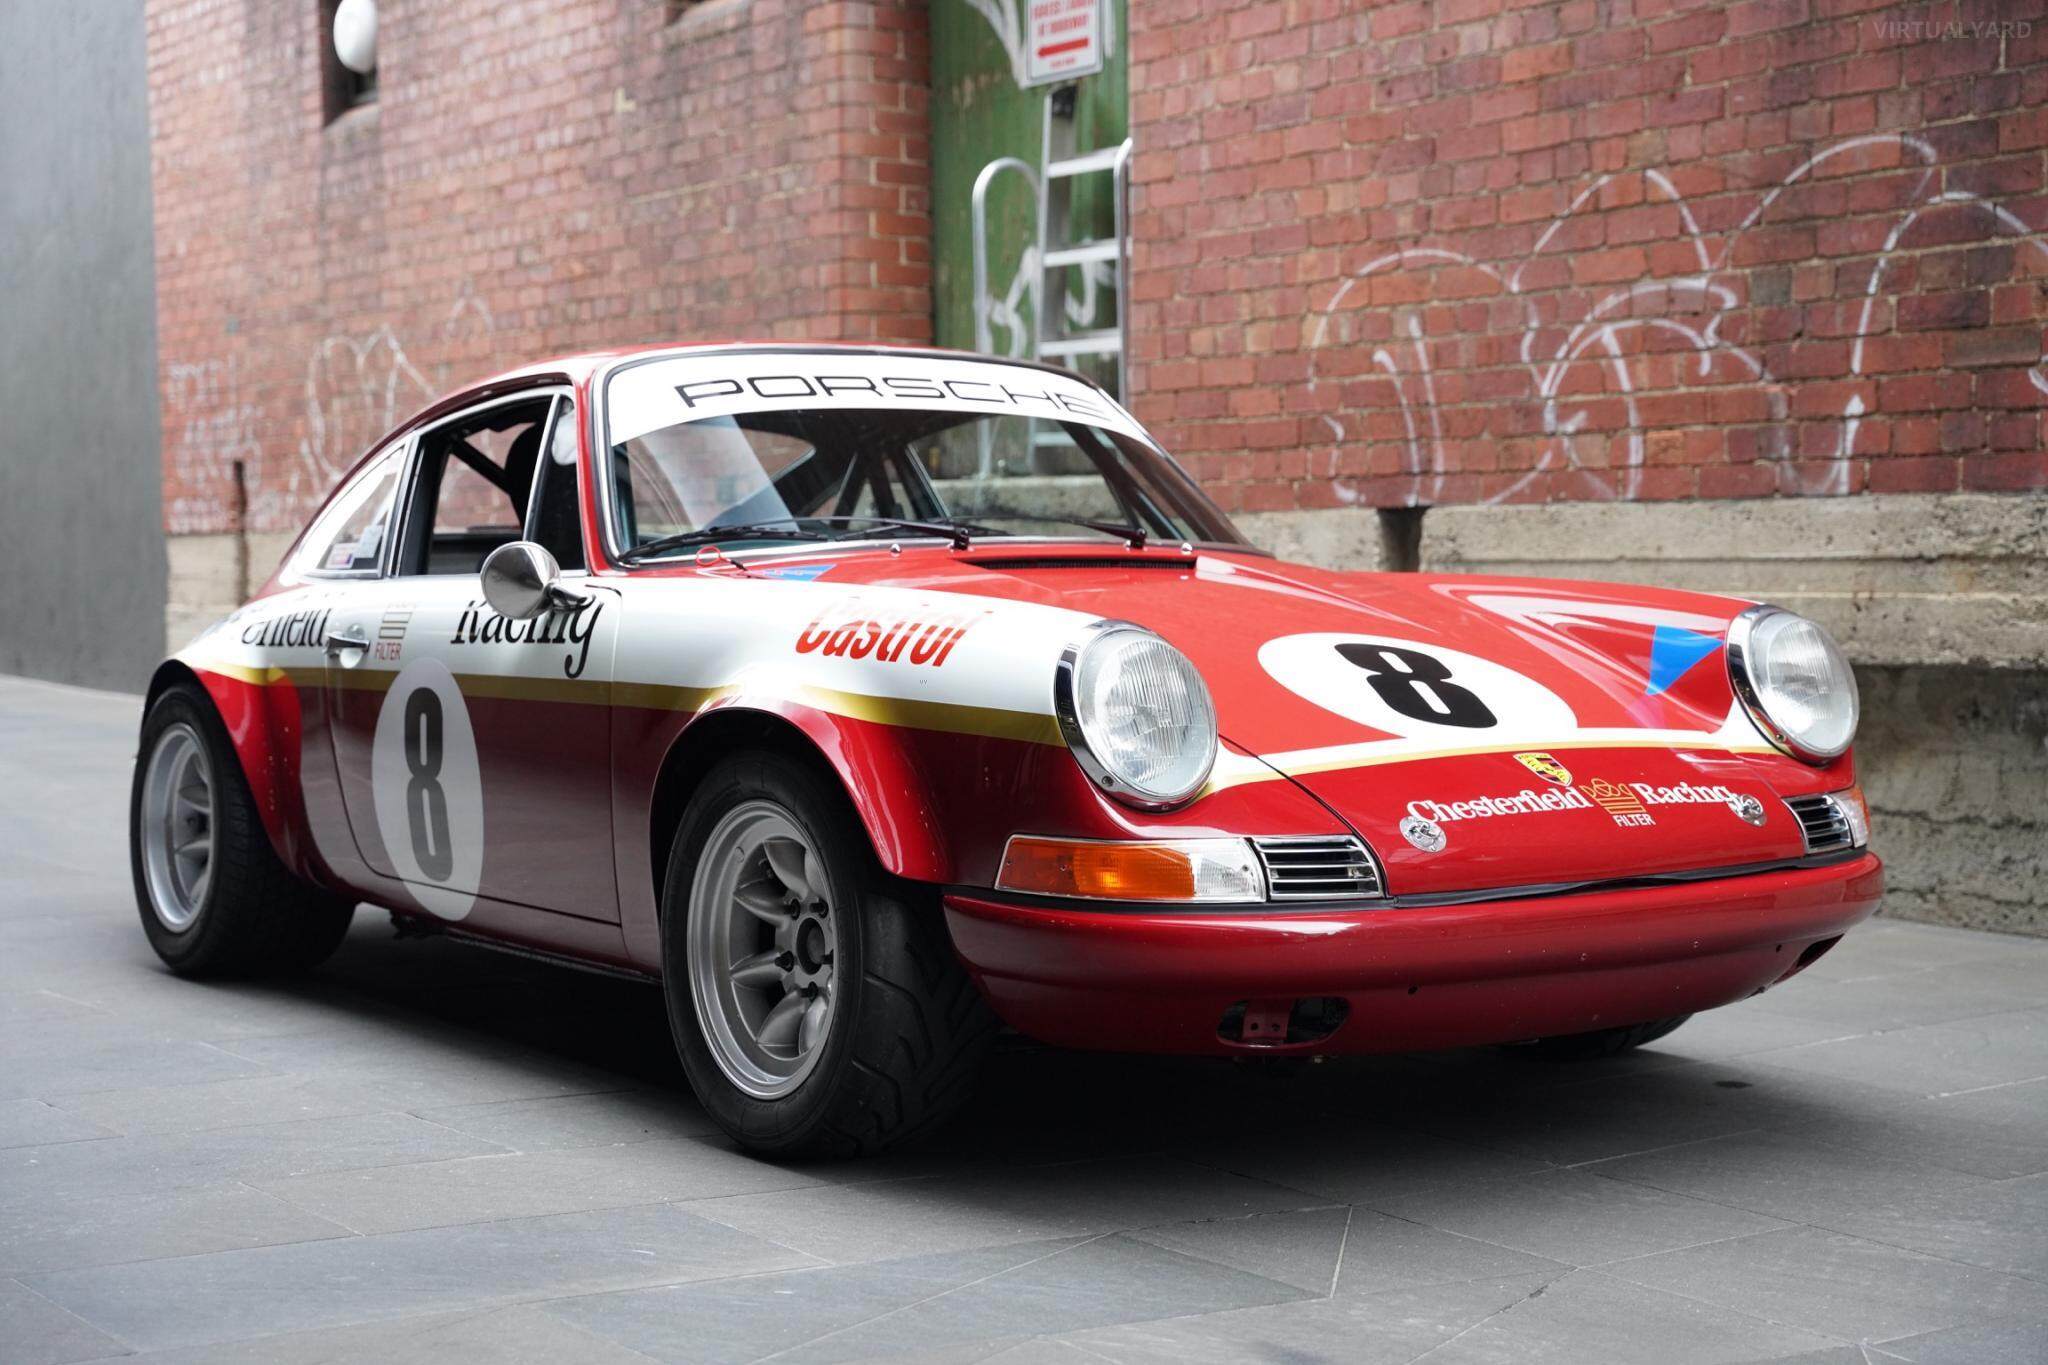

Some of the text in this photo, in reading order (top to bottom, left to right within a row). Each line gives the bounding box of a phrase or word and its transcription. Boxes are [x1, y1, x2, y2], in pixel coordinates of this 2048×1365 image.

[675, 375, 1112, 422] PORSCHE
[1334, 643, 1498, 728] 8
[404, 687, 453, 882] 8
[1407, 781, 1744, 823] Chesterfield Racing
[1612, 813, 1656, 827] FILTER
